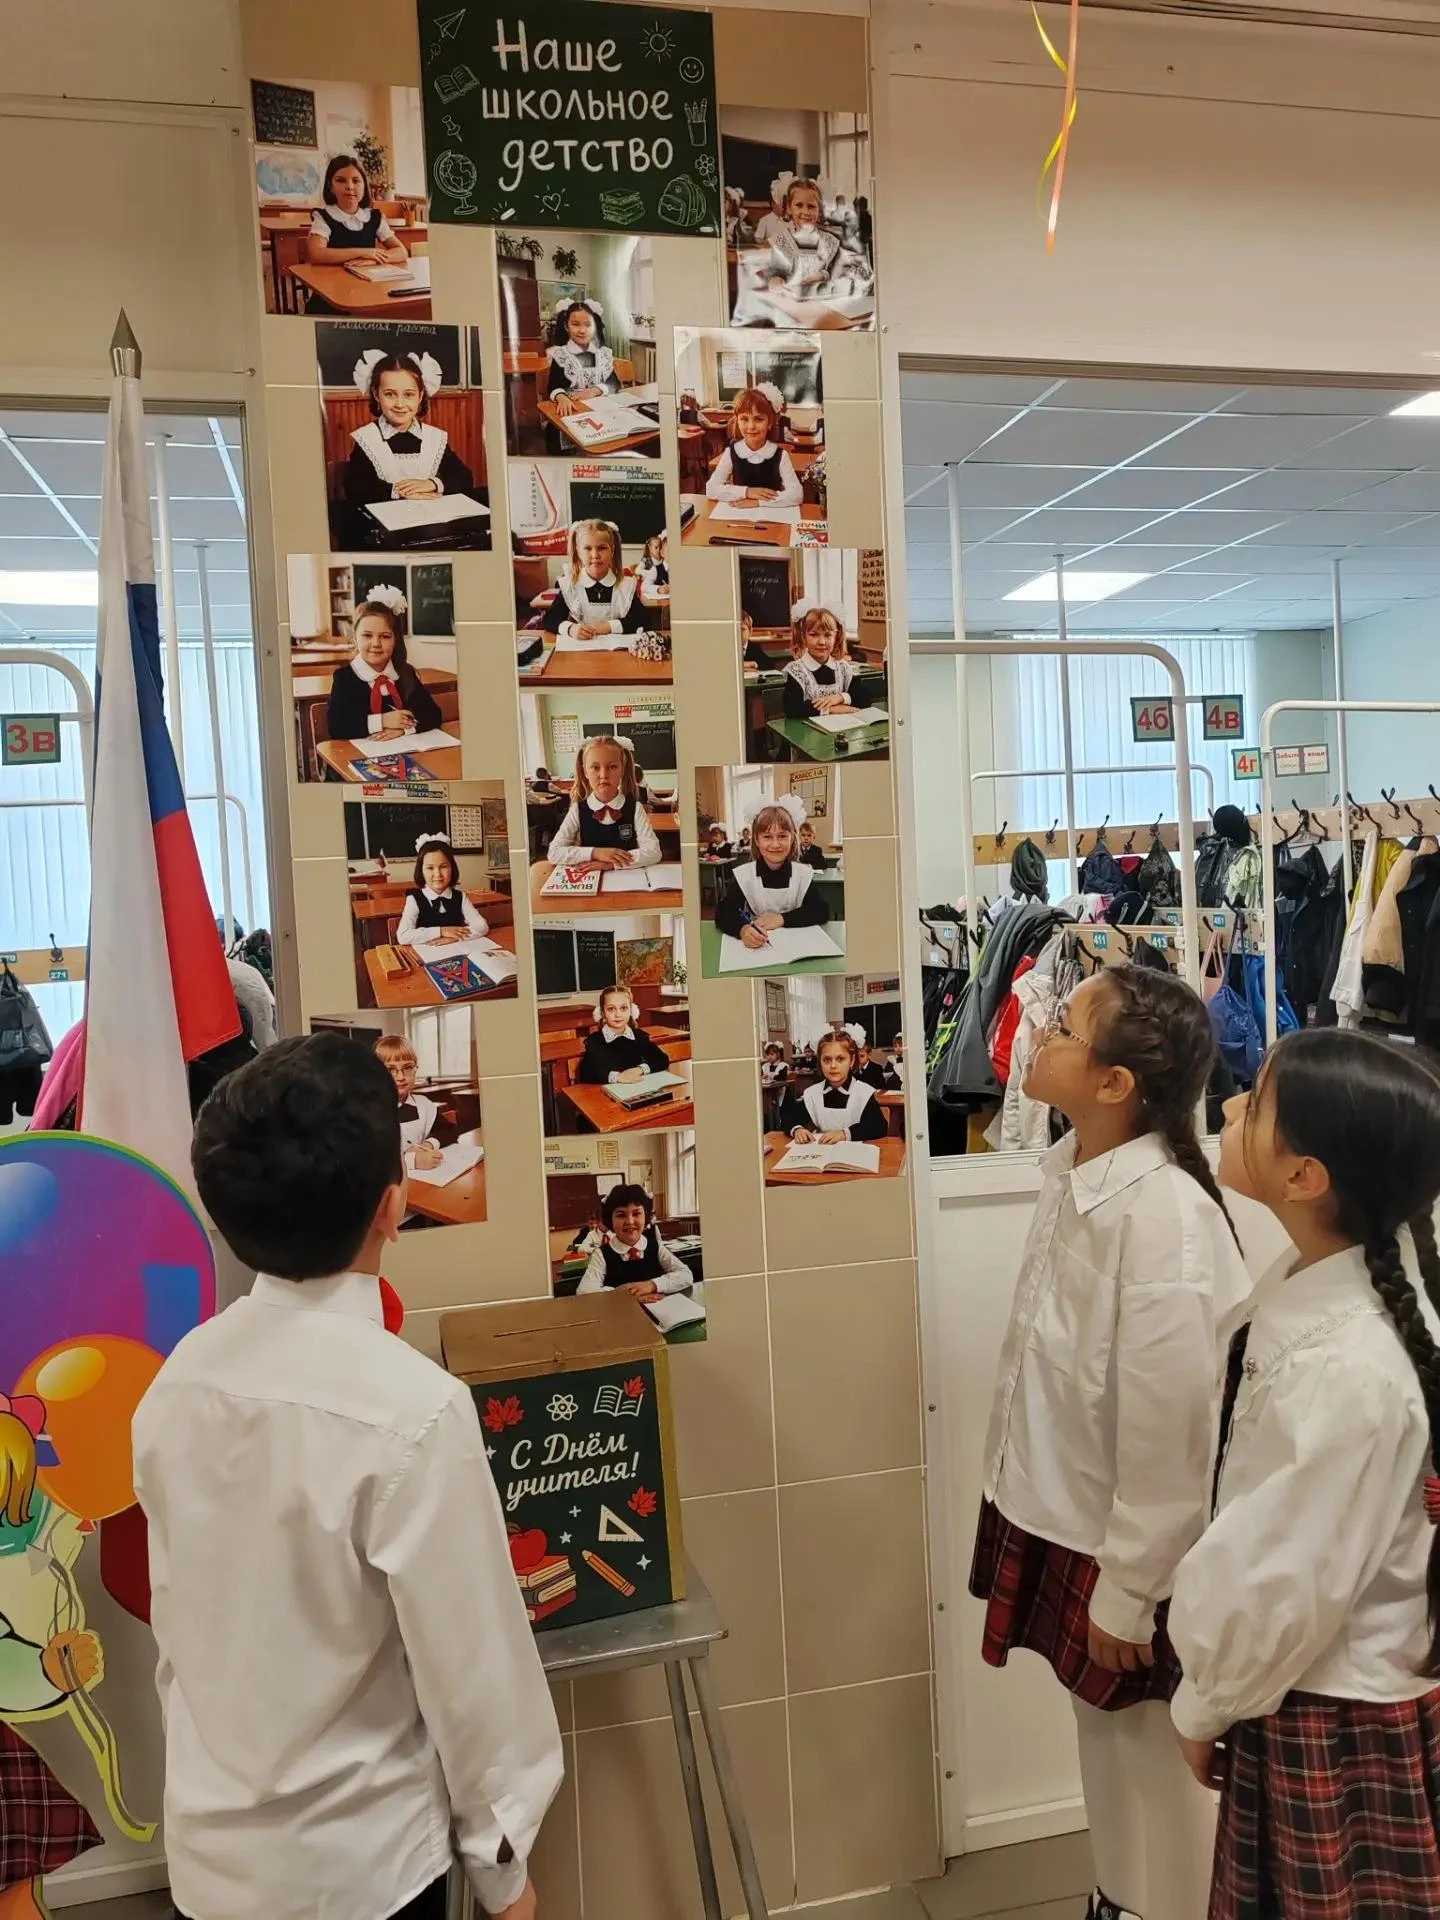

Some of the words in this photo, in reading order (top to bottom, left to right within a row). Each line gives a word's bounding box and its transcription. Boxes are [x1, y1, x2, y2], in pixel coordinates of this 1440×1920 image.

[492, 18, 623, 73] Наше
[482, 87, 674, 121] школьное
[498, 137, 674, 192] детство
[1137, 706, 1169, 731] 4б
[1206, 704, 1240, 730] 4в
[7, 723, 56, 754] 3в
[1237, 755, 1258, 773] 4г
[510, 1439, 532, 1470] С
[540, 1432, 628, 1466] Днём
[506, 1451, 640, 1512] учителя!
